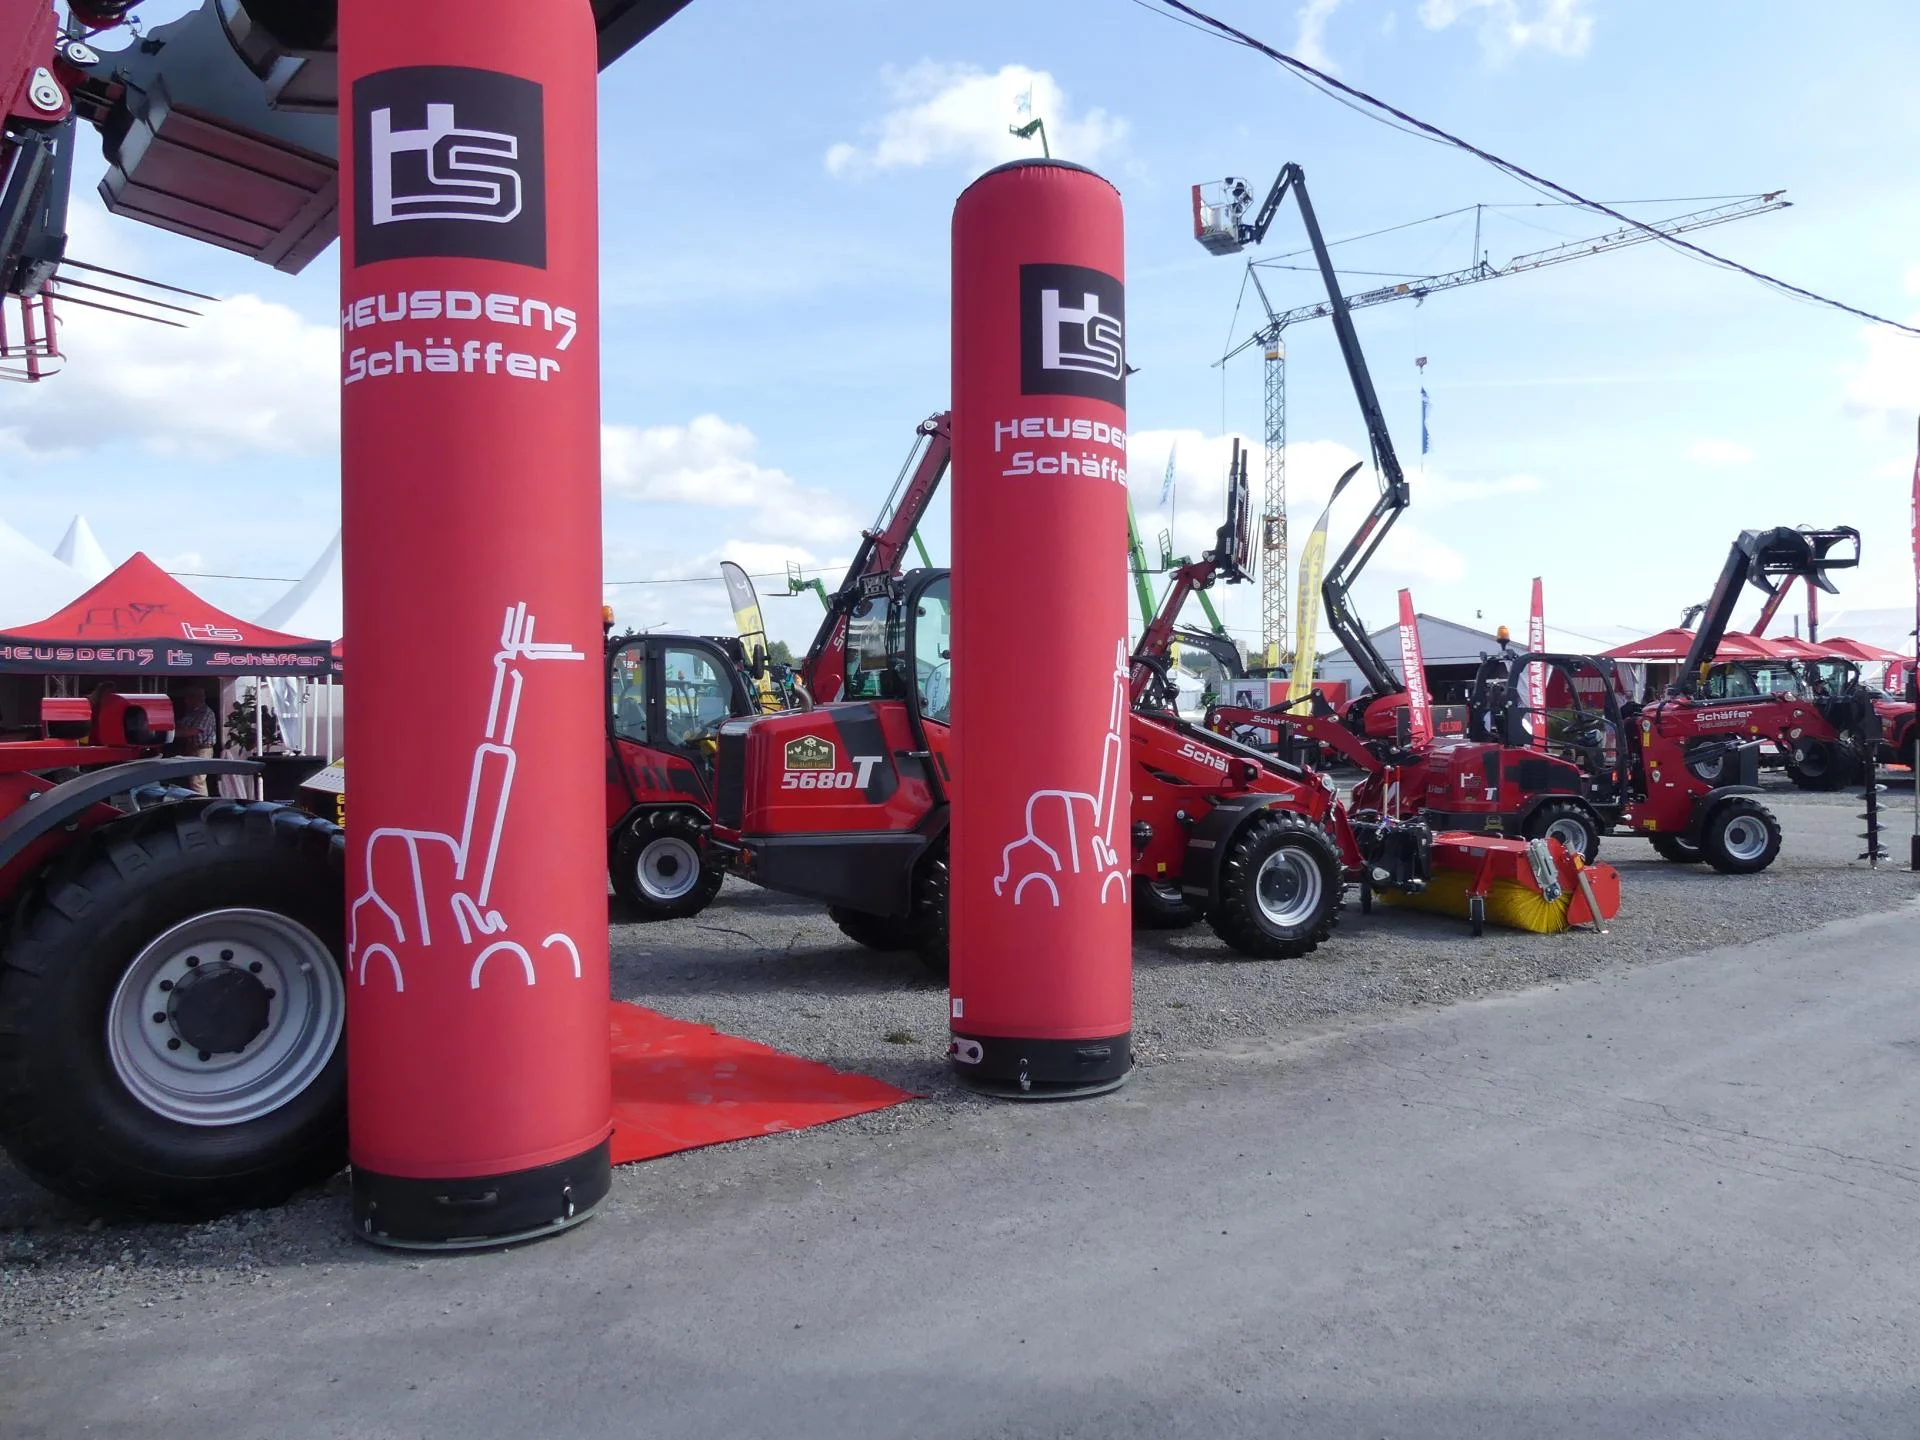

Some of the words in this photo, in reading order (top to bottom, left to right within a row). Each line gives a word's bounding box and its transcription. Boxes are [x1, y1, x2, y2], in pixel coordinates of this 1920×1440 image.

[344, 337, 561, 386] Schäffer
[206, 652, 325, 666] Schäffer
[1400, 625, 1420, 708] MANITOU
[1530, 616, 1544, 705] MANTOU
[1693, 710, 1753, 722] Schäffer
